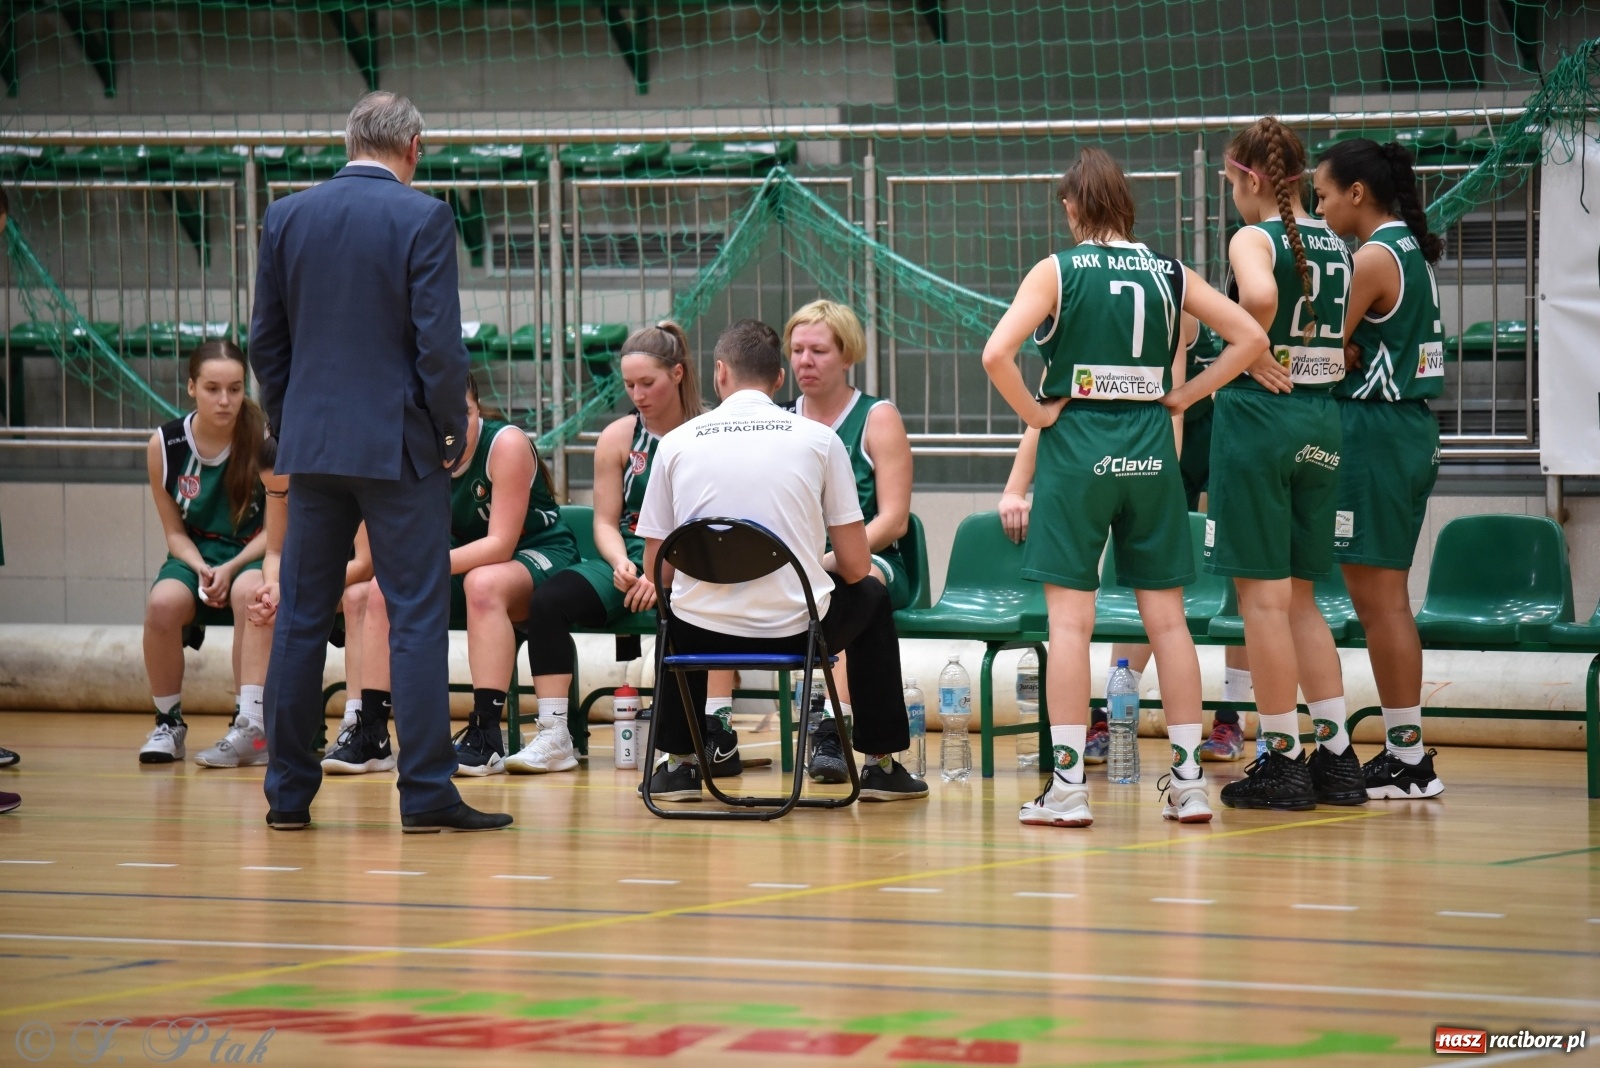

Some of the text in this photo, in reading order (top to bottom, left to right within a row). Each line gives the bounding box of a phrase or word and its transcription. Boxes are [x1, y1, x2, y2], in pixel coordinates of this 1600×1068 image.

[1072, 254, 1174, 275] RKK RACIBÓRZ
[1290, 259, 1350, 338] 23
[1109, 280, 1146, 358] 7
[1291, 362, 1345, 376] WAGTECH
[1095, 372, 1145, 383] wydawnictwo
[1095, 380, 1162, 394] WAGTECH
[696, 422, 792, 438] AZS RACIBÓRZ
[1111, 456, 1163, 472] Clavis
[1304, 446, 1341, 467] Clavis
[624, 748, 630, 757] 3
